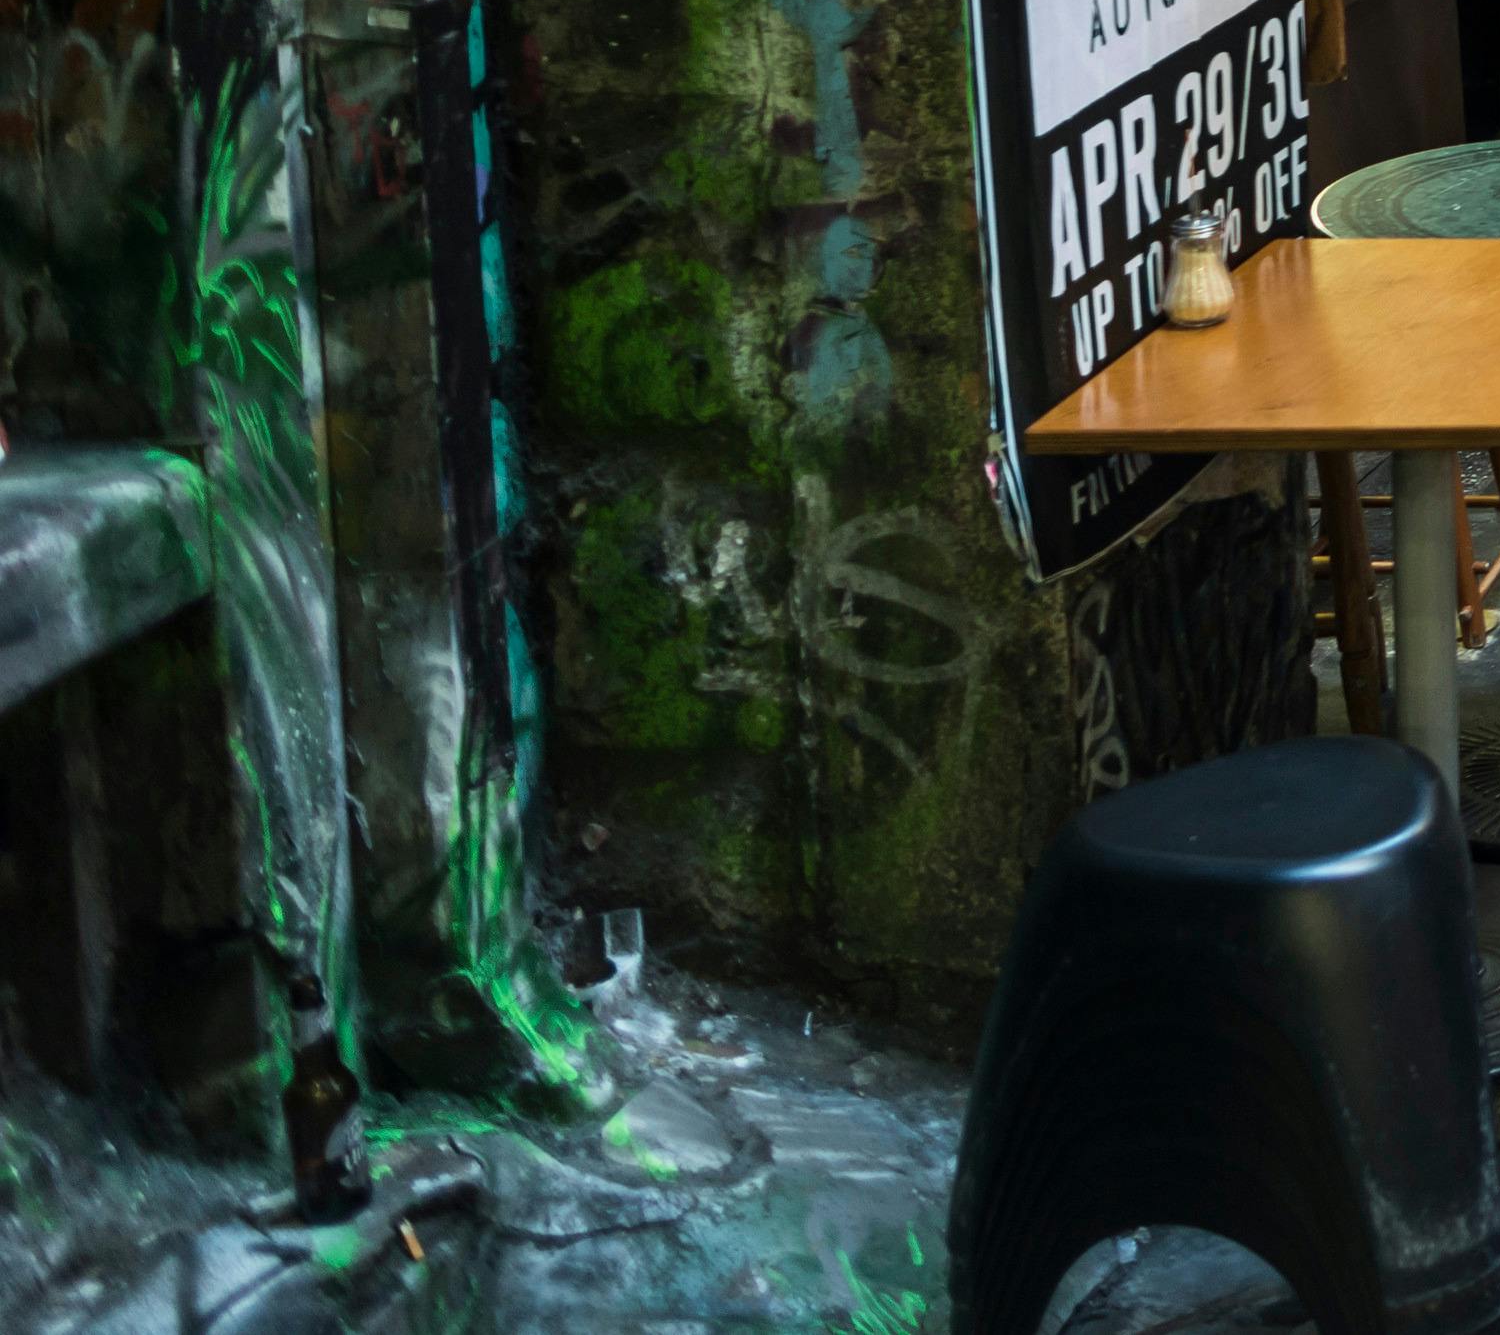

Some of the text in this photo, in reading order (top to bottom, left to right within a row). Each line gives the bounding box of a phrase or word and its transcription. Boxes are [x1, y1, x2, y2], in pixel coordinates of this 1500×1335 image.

[1070, 278, 1116, 379] UP
[1124, 242, 1165, 332] TO
[1254, 133, 1309, 236] OFF
